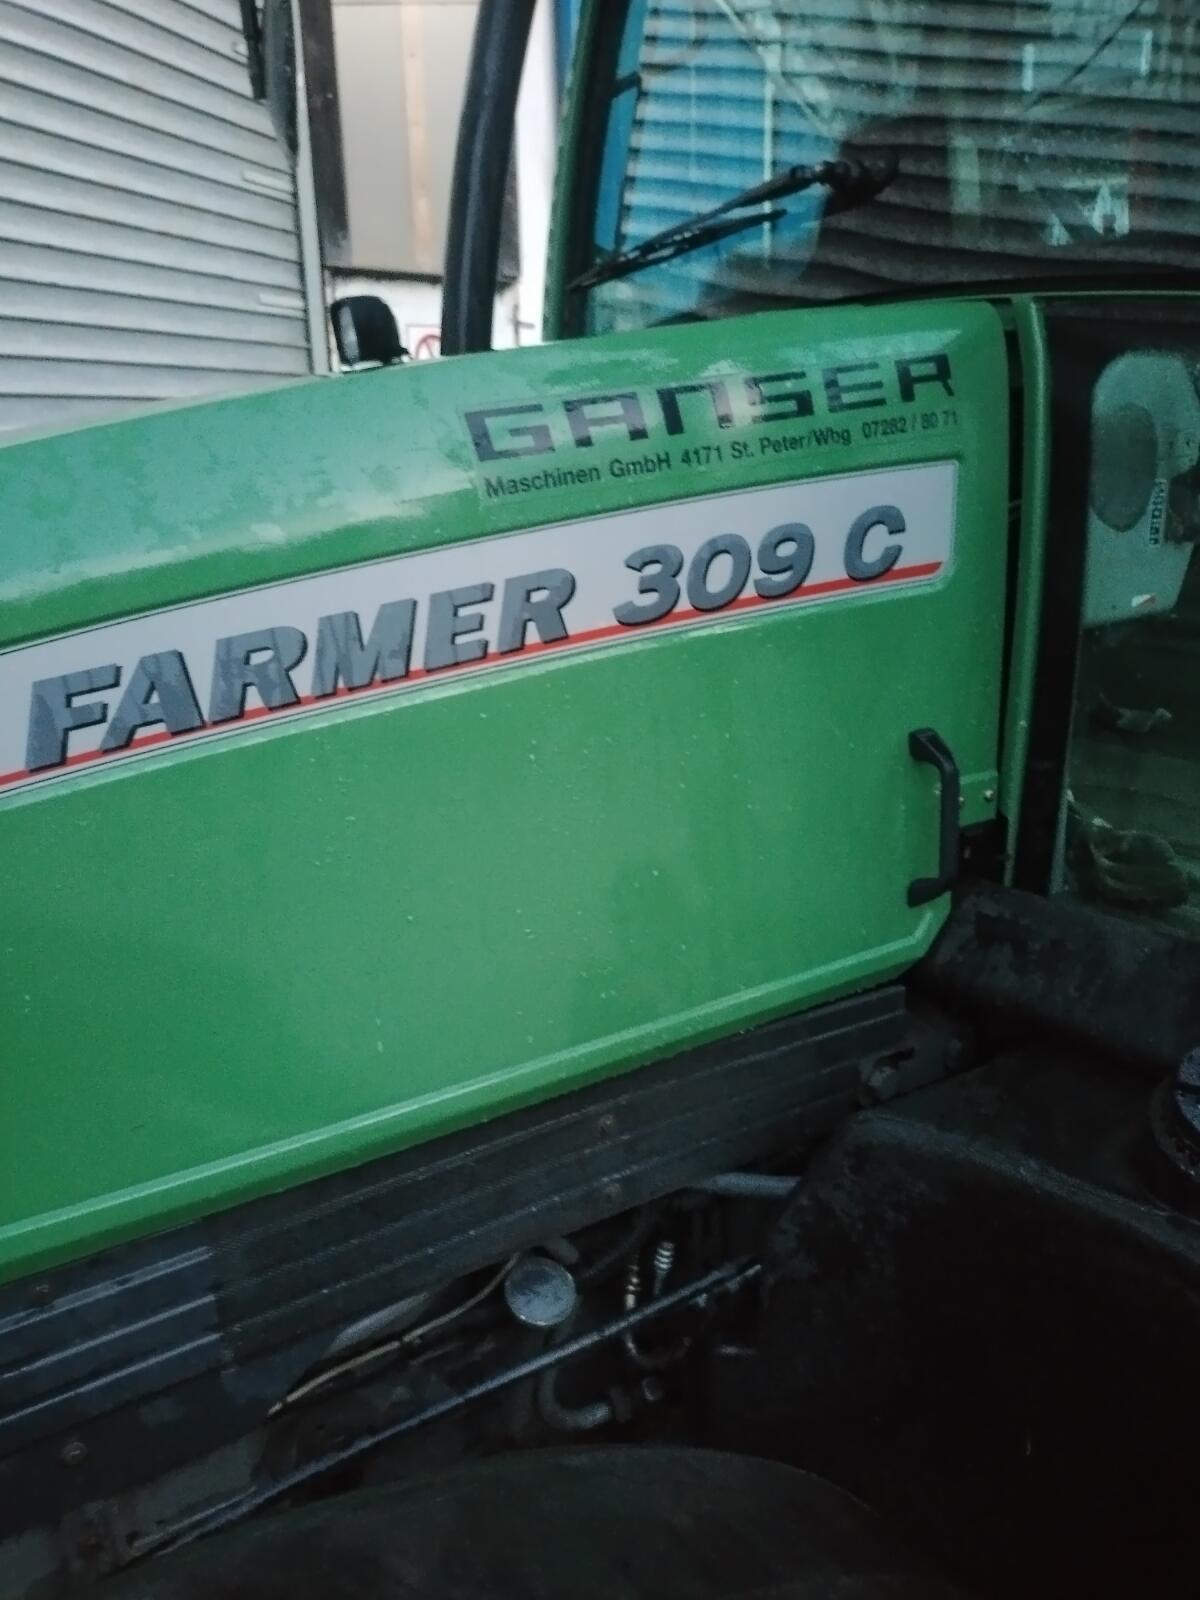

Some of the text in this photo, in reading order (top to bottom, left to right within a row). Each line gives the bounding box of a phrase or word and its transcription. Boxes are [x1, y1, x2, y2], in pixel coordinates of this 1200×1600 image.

[464, 353, 954, 462] GANSER
[485, 464, 601, 498] Maschinen
[608, 451, 672, 478] GmbH
[681, 445, 723, 466] 4171
[730, 441, 754, 460] St.
[759, 427, 852, 455] Peter/Wbg
[942, 410, 958, 426] 71
[25, 504, 906, 773] FARMER 309 C
